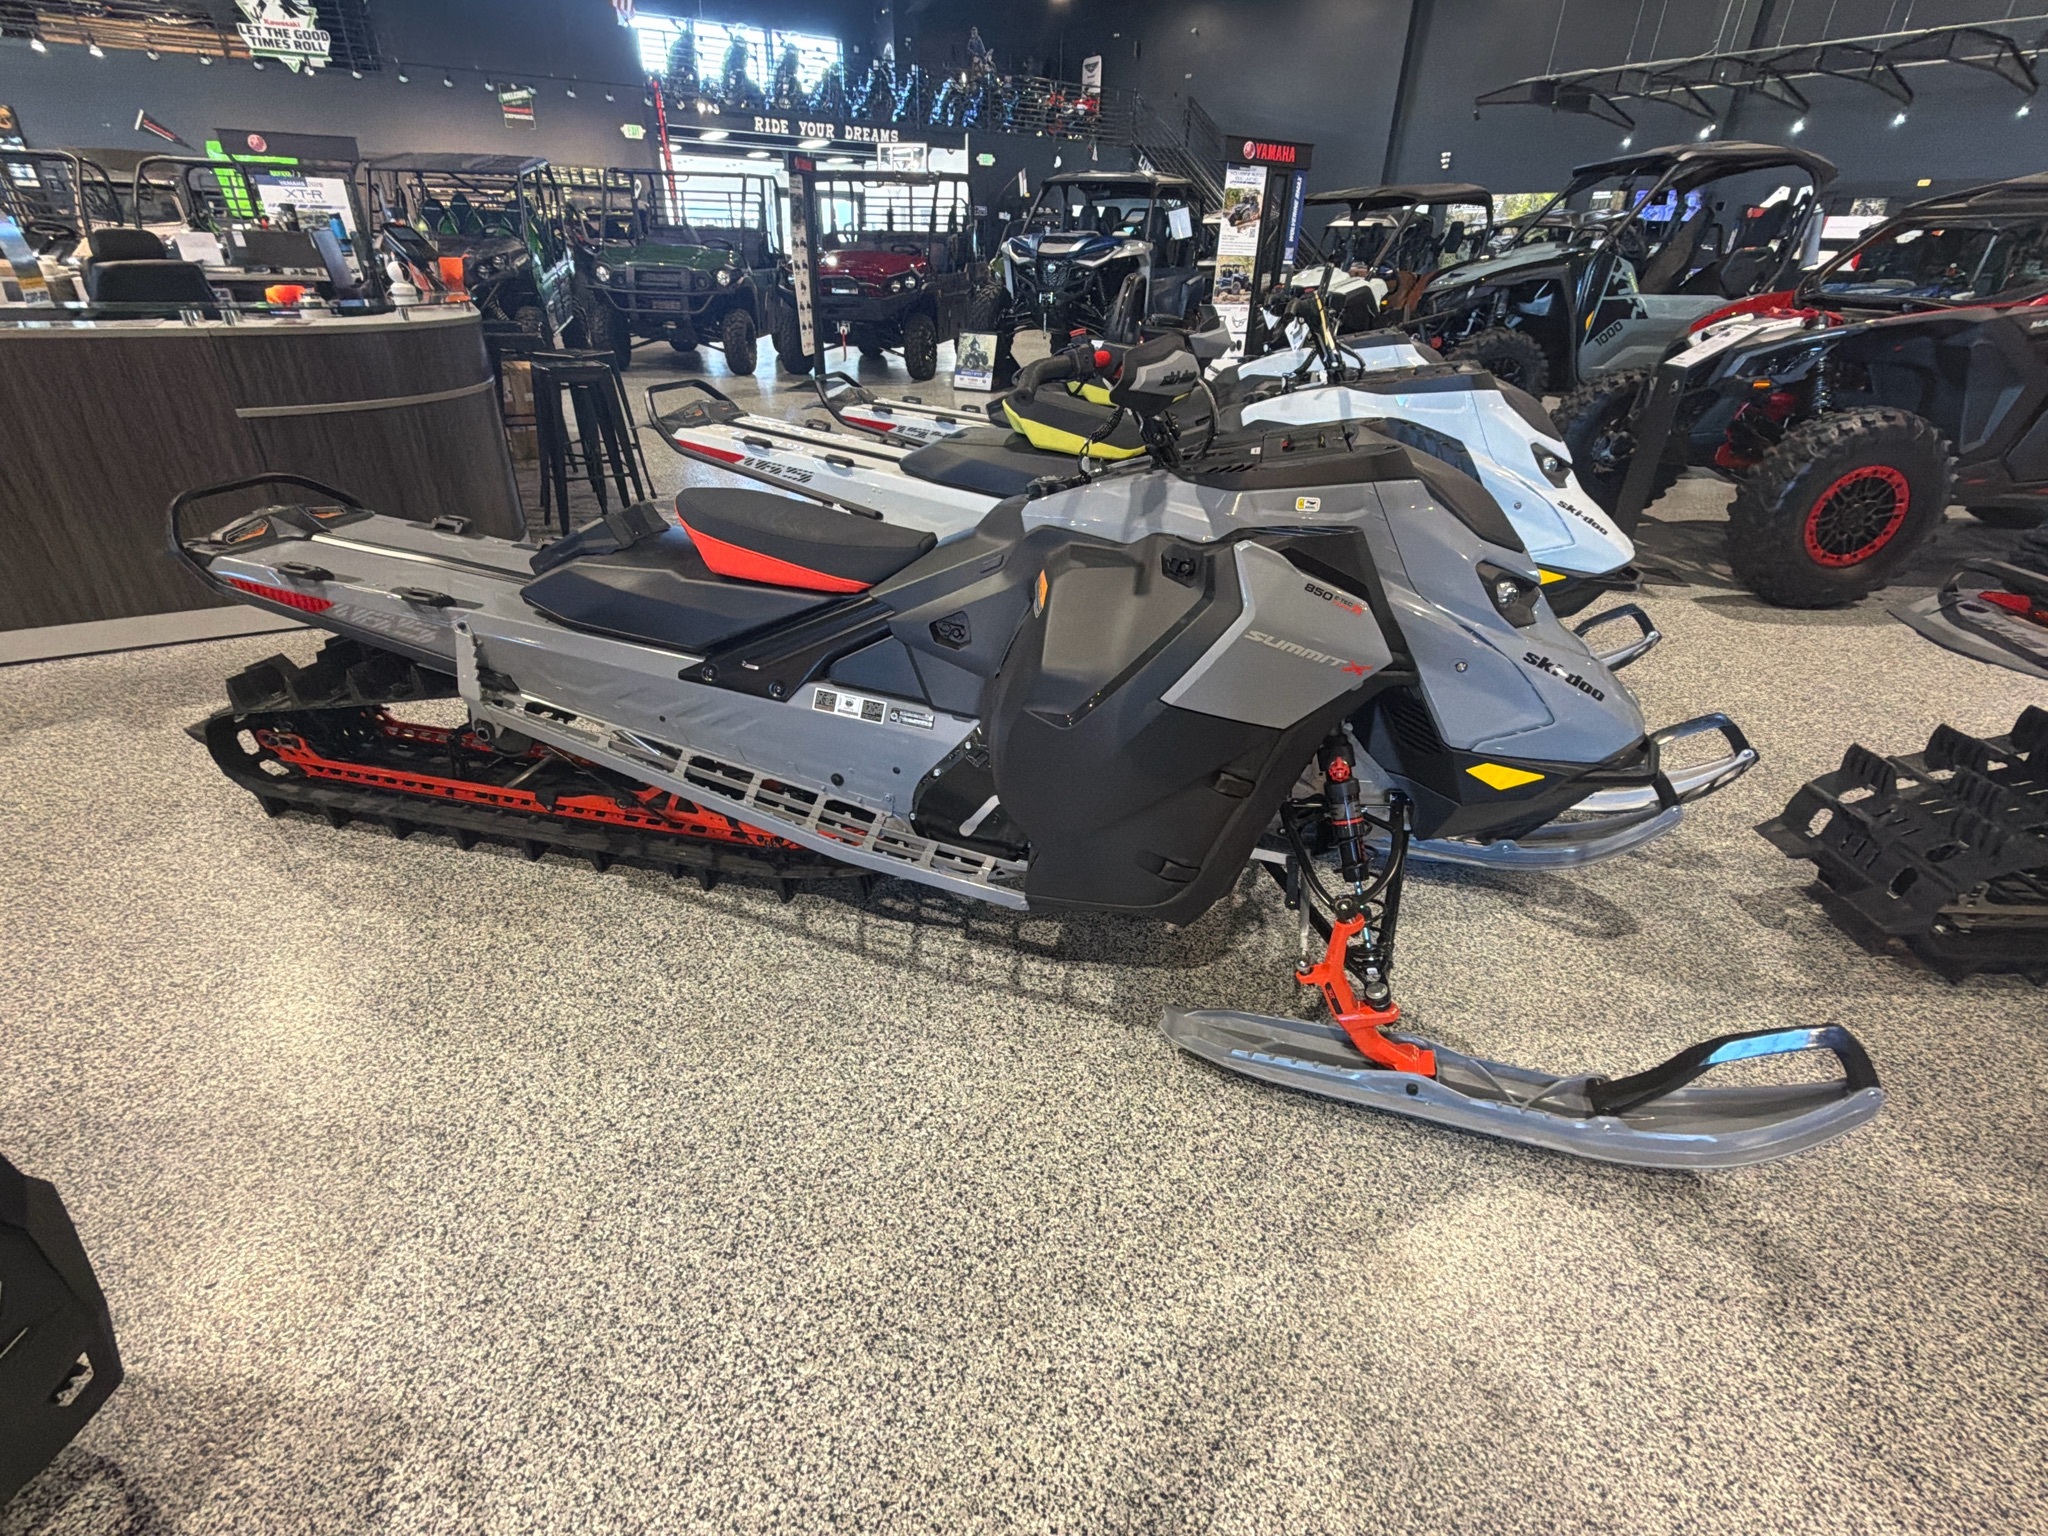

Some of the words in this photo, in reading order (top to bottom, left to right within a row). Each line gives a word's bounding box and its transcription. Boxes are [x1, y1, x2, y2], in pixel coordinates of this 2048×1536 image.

[239, 24, 262, 36] LET
[264, 26, 291, 39] THE
[293, 28, 330, 42] GOOD
[249, 36, 291, 50] TIMES
[293, 40, 327, 53] ROLL
[754, 115, 790, 134] RIDE
[798, 120, 836, 139] YOUR
[844, 124, 899, 143] DREAMS
[1255, 142, 1296, 163] YAMAHA
[284, 188, 325, 200] XT-R
[1288, 199, 1300, 243] WOLVERINE
[1594, 320, 1624, 347] 1000
[1556, 499, 1609, 536] ski-doo
[1304, 583, 1334, 602] 850
[1244, 629, 1349, 667] SUMMIT
[1340, 660, 1374, 677] X
[1522, 651, 1606, 703] skidoo
